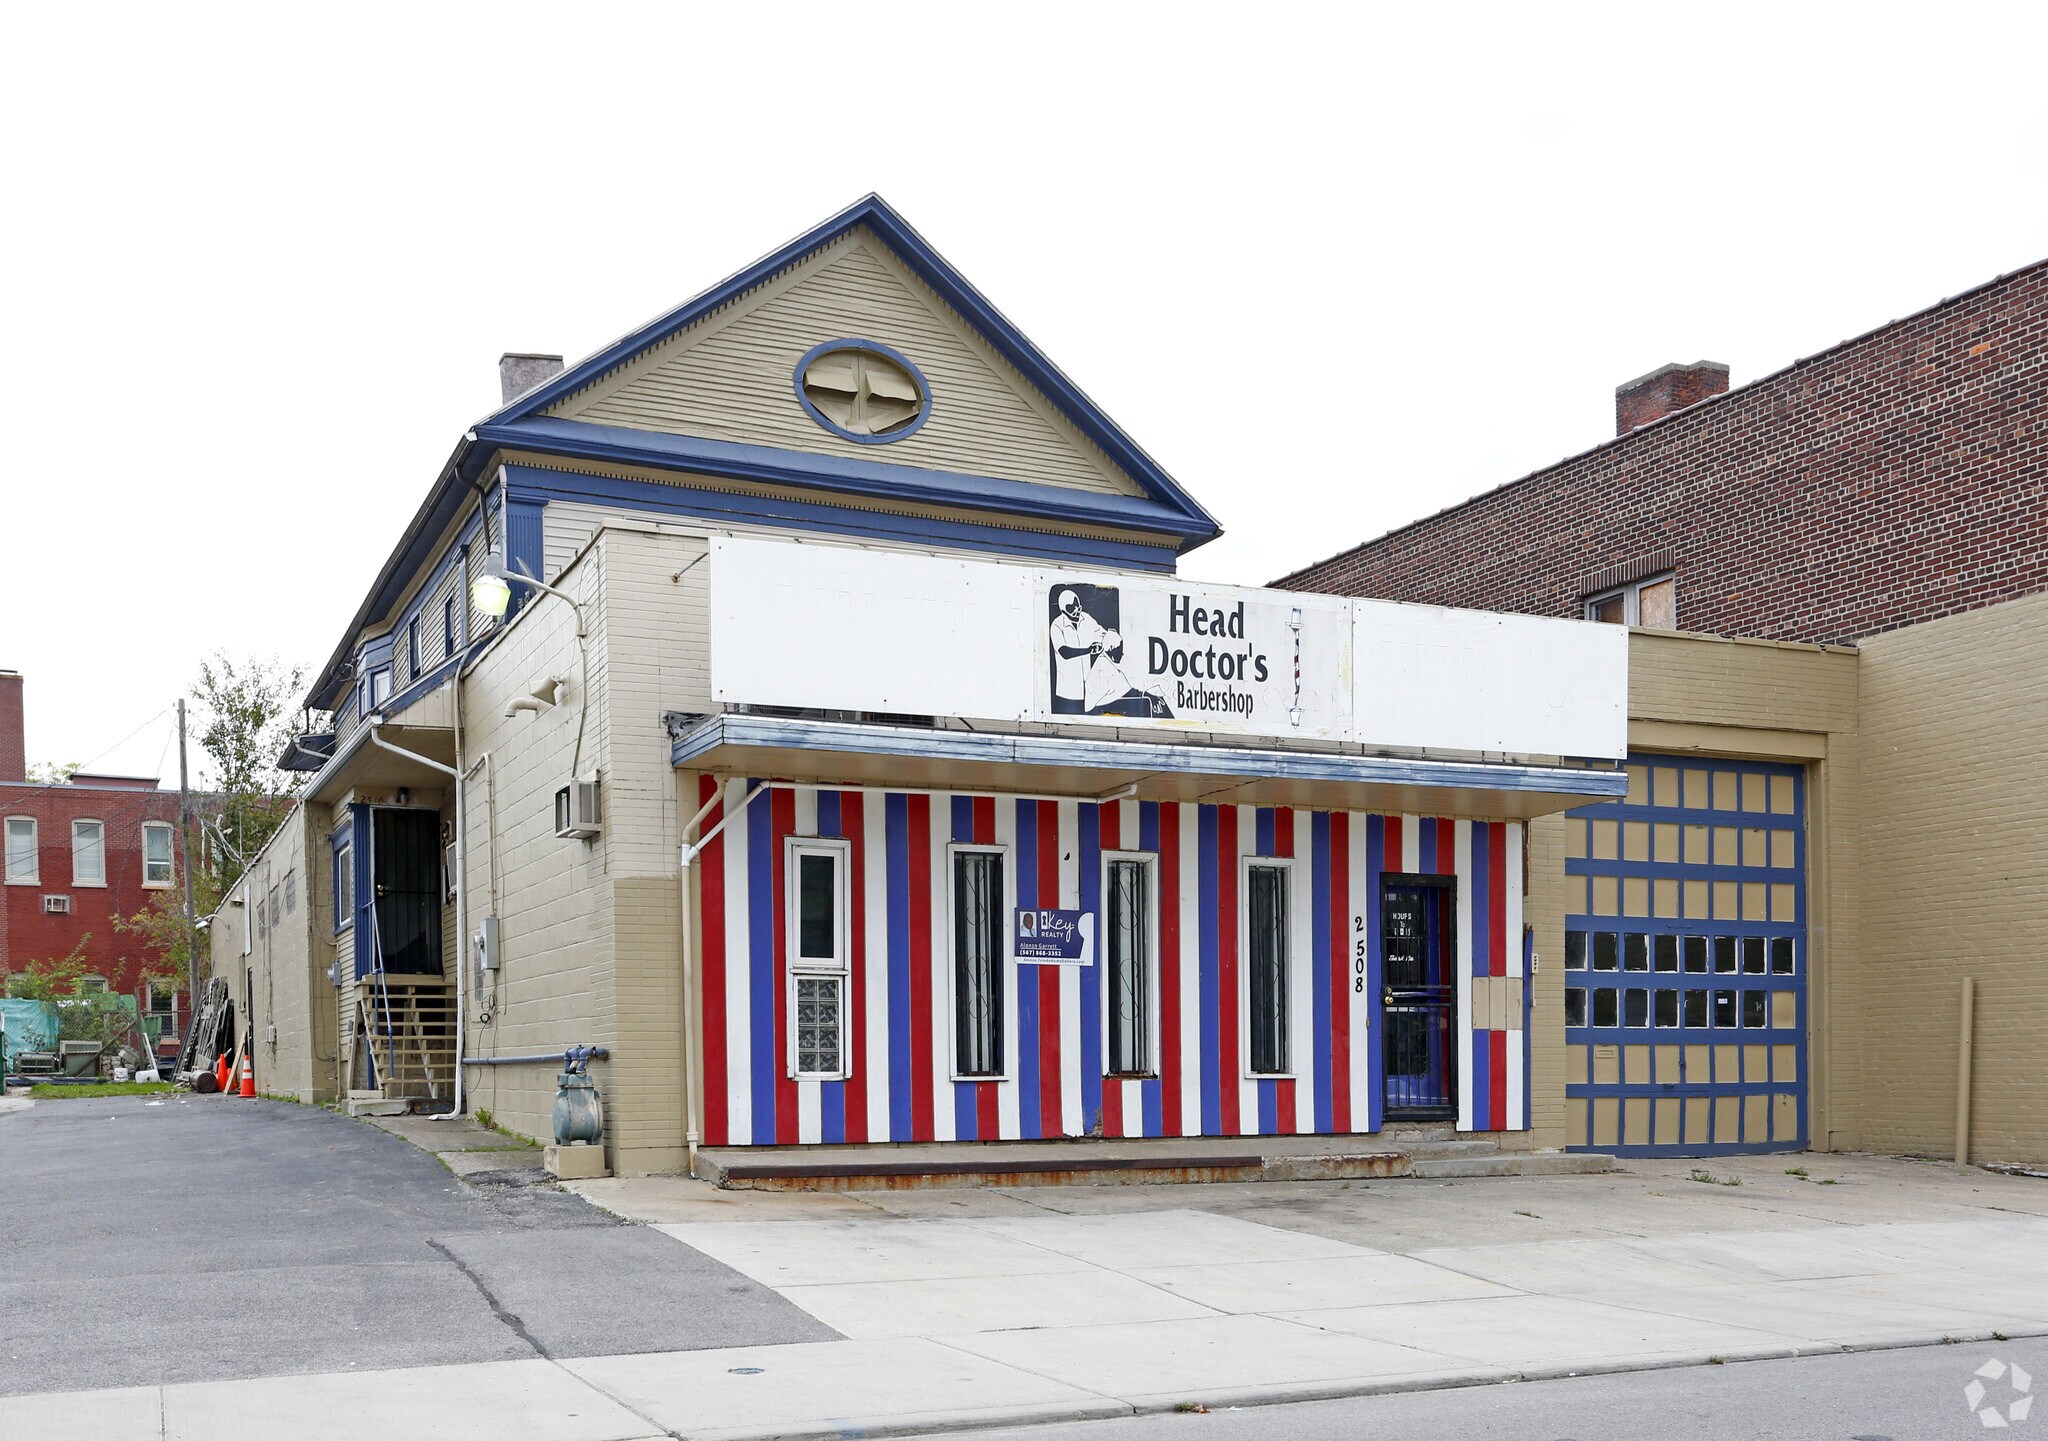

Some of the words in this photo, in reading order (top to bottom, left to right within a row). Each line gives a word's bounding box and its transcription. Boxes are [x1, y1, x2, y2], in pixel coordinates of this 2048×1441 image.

[1169, 593, 1244, 639] Head
[1148, 636, 1268, 682] Doctor's
[1177, 681, 1253, 719] Barbershop
[1048, 911, 1074, 942] Key
[1355, 916, 1365, 993] 2508
